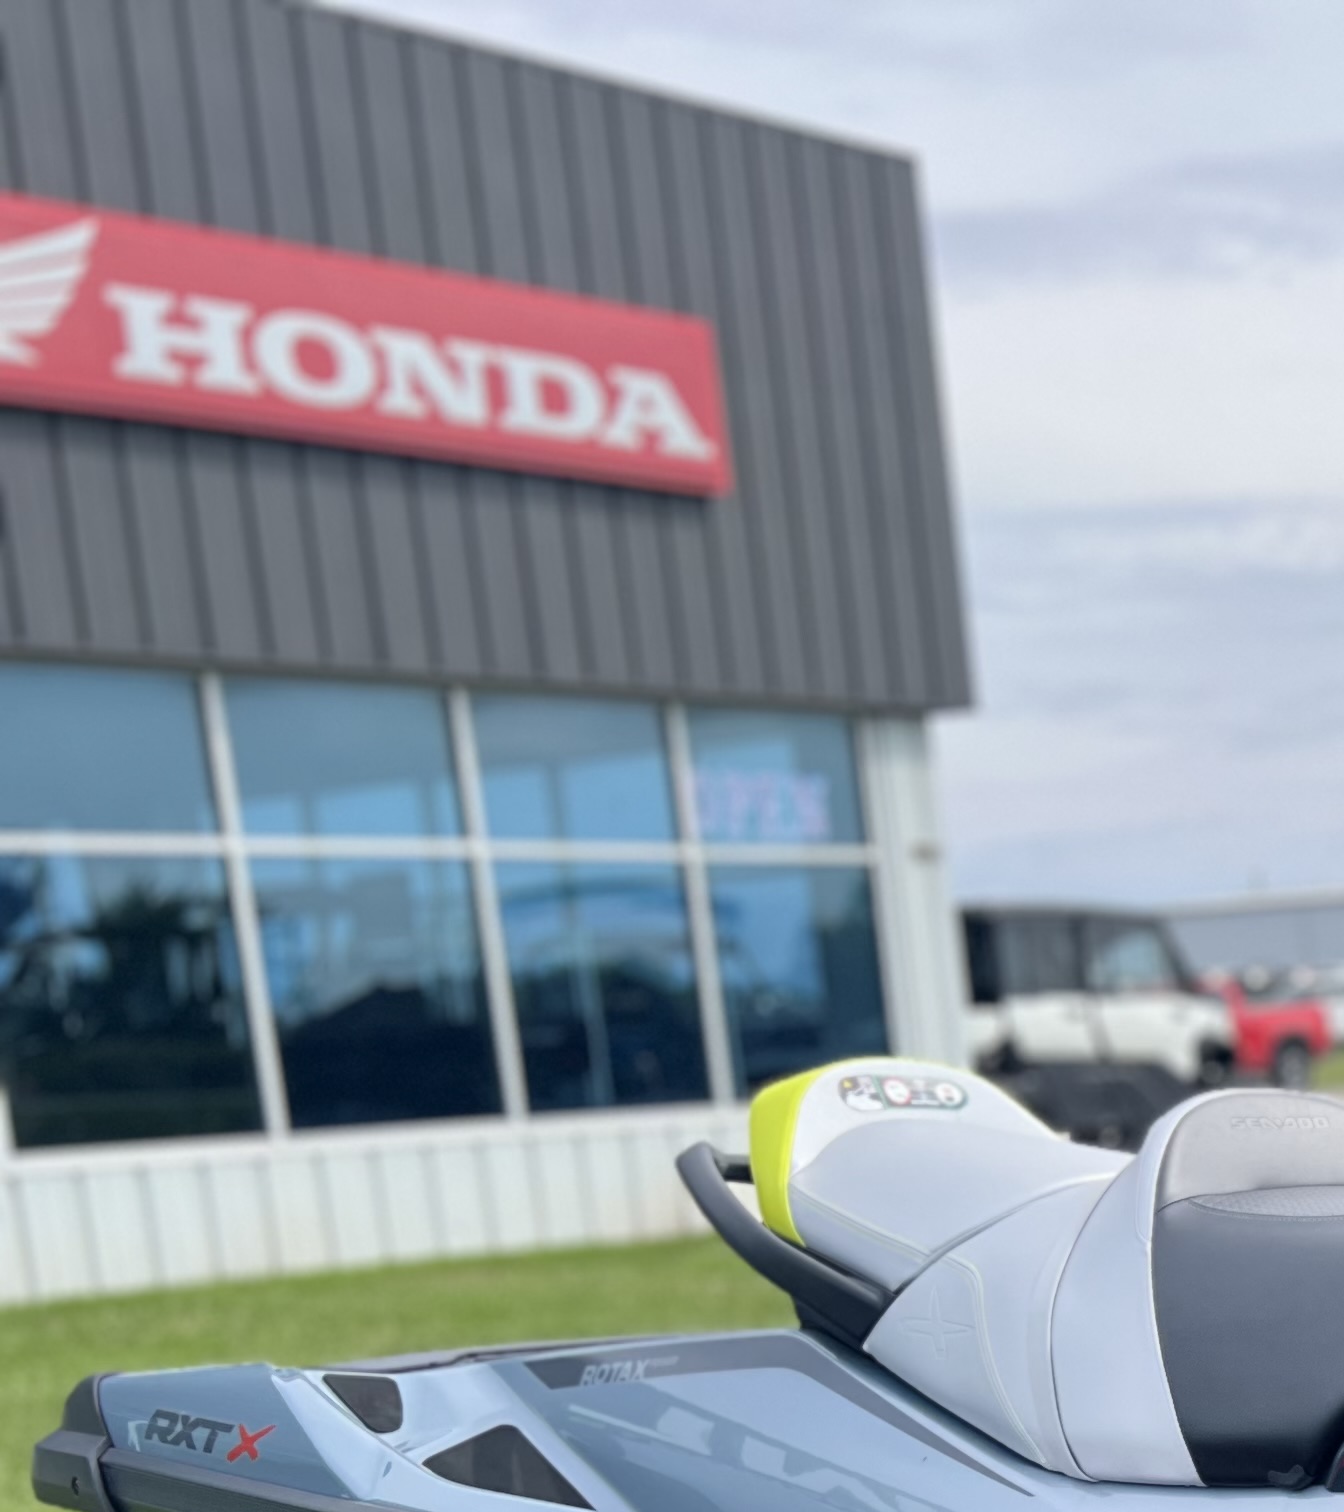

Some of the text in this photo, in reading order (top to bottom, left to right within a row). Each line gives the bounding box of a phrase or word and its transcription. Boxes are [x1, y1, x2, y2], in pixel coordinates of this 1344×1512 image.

[104, 284, 716, 460] HONDA
[581, 1360, 649, 1386] ROTAX
[144, 1408, 276, 1463] RXT X
